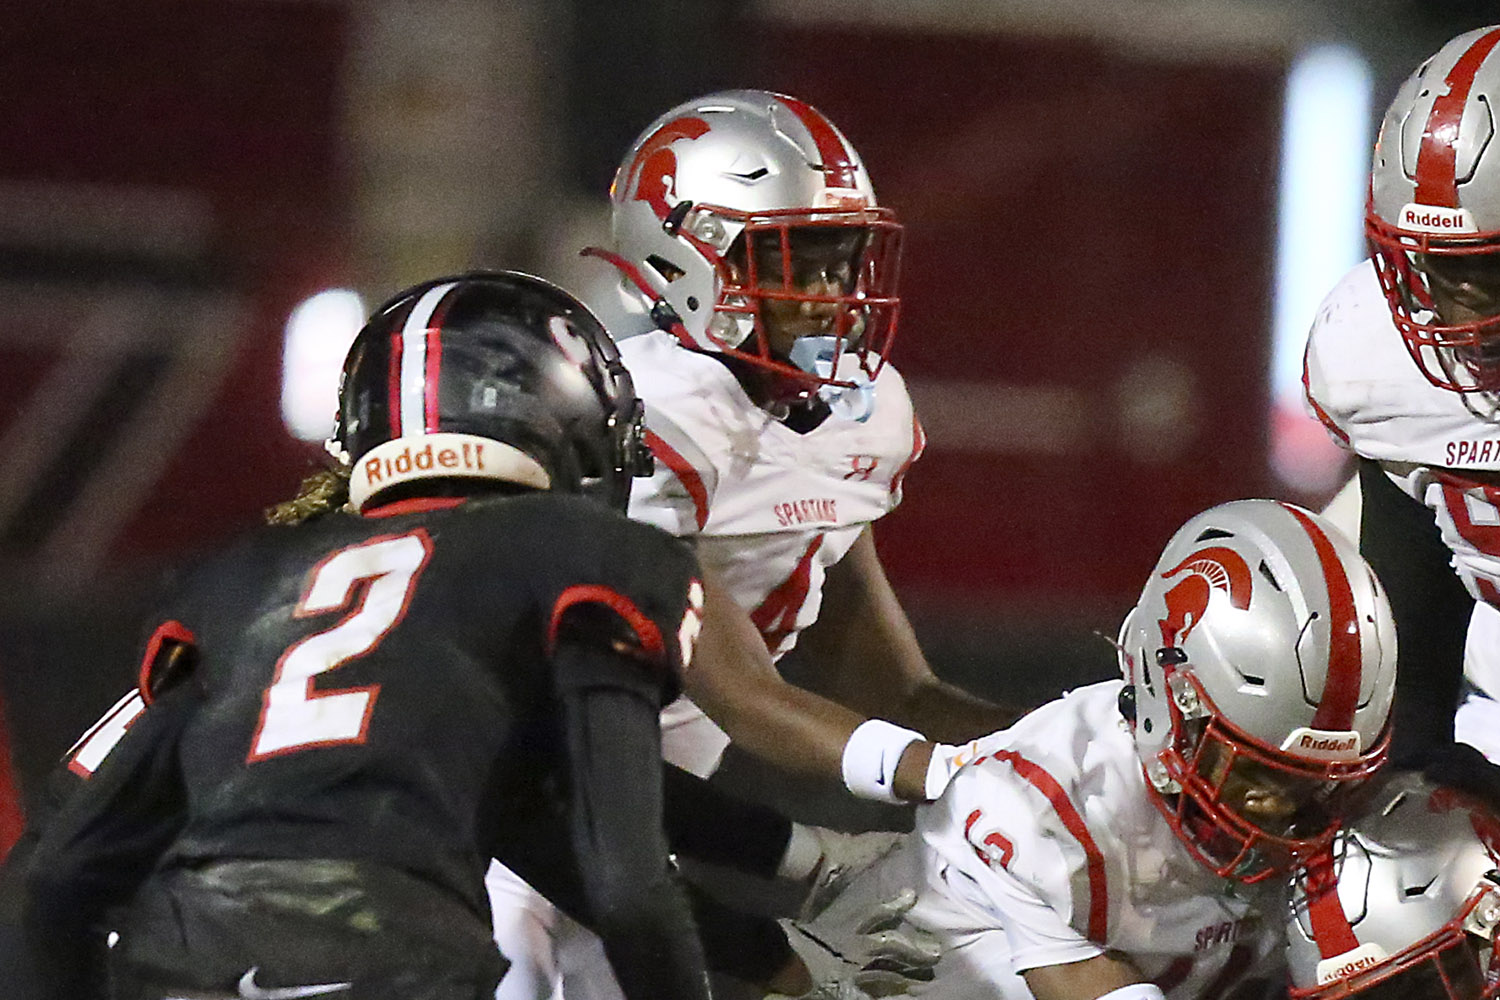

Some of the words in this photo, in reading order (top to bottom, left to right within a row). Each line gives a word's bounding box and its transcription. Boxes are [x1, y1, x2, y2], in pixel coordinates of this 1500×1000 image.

[1406, 211, 1463, 228] Riddell
[365, 443, 485, 485] Riddell
[247, 528, 432, 763] 2
[1300, 735, 1357, 751] Riddell
